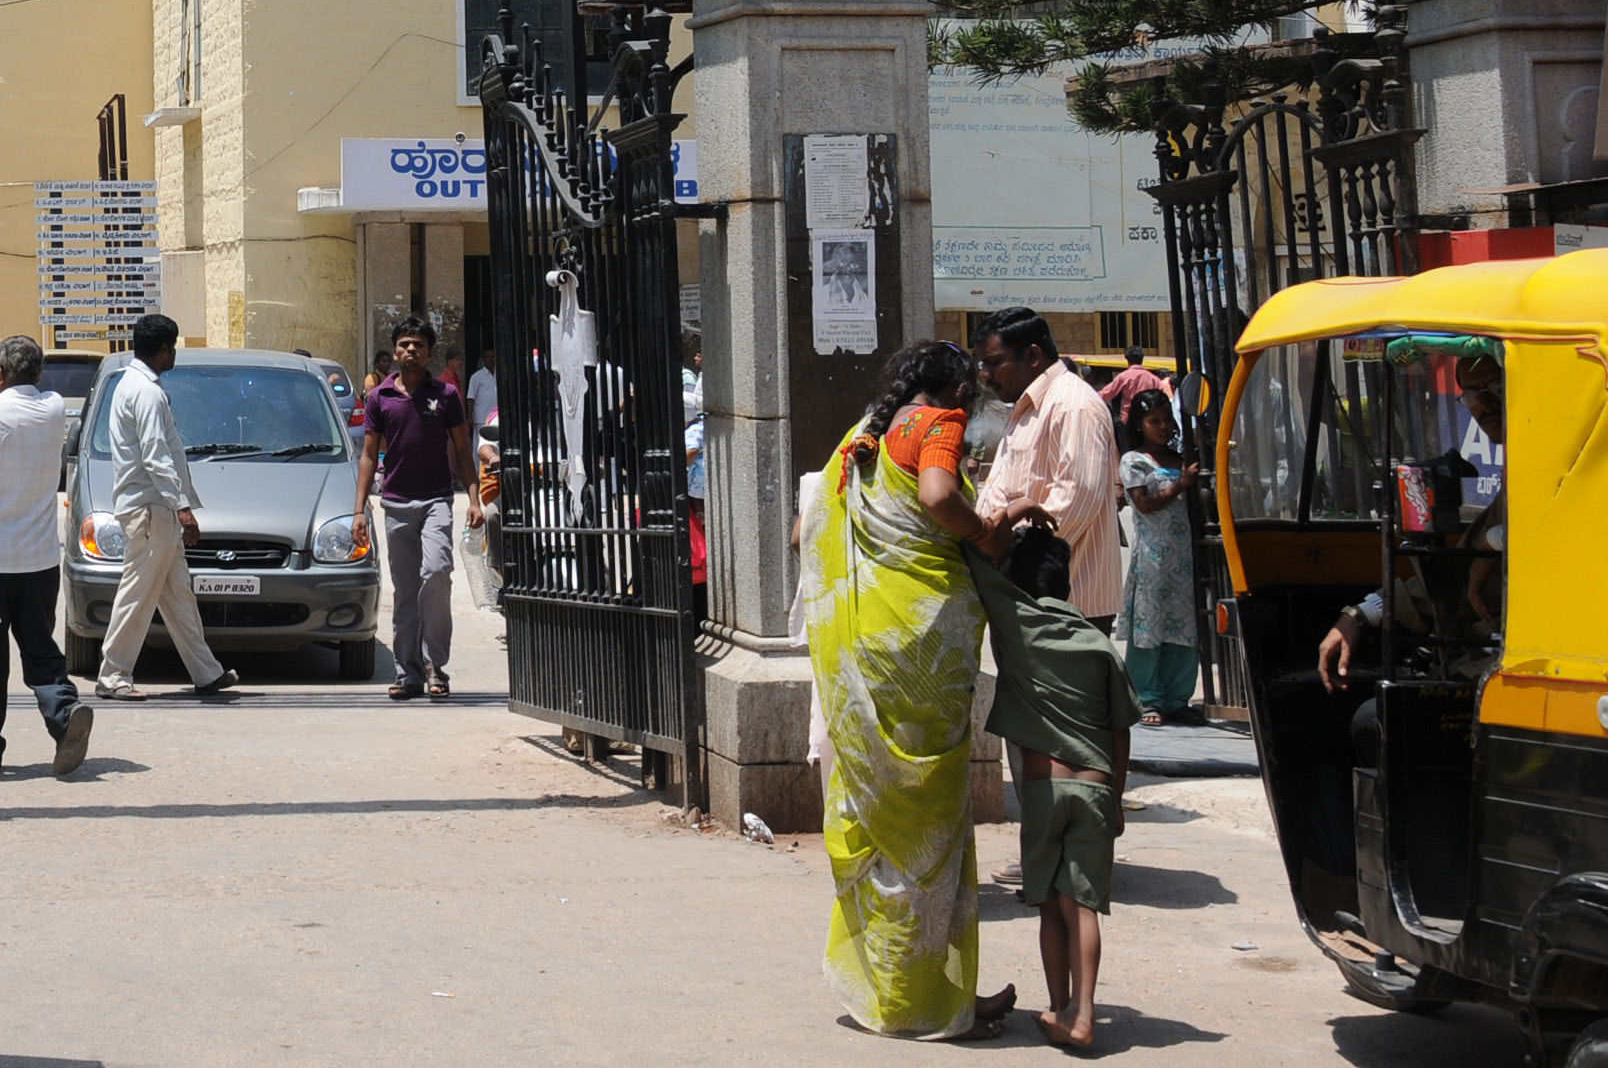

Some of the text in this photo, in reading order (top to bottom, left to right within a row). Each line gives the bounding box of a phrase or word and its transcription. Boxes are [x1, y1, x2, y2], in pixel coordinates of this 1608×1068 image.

[415, 179, 486, 198] OUT
[199, 584, 213, 592] KA
[214, 584, 223, 592] 01
